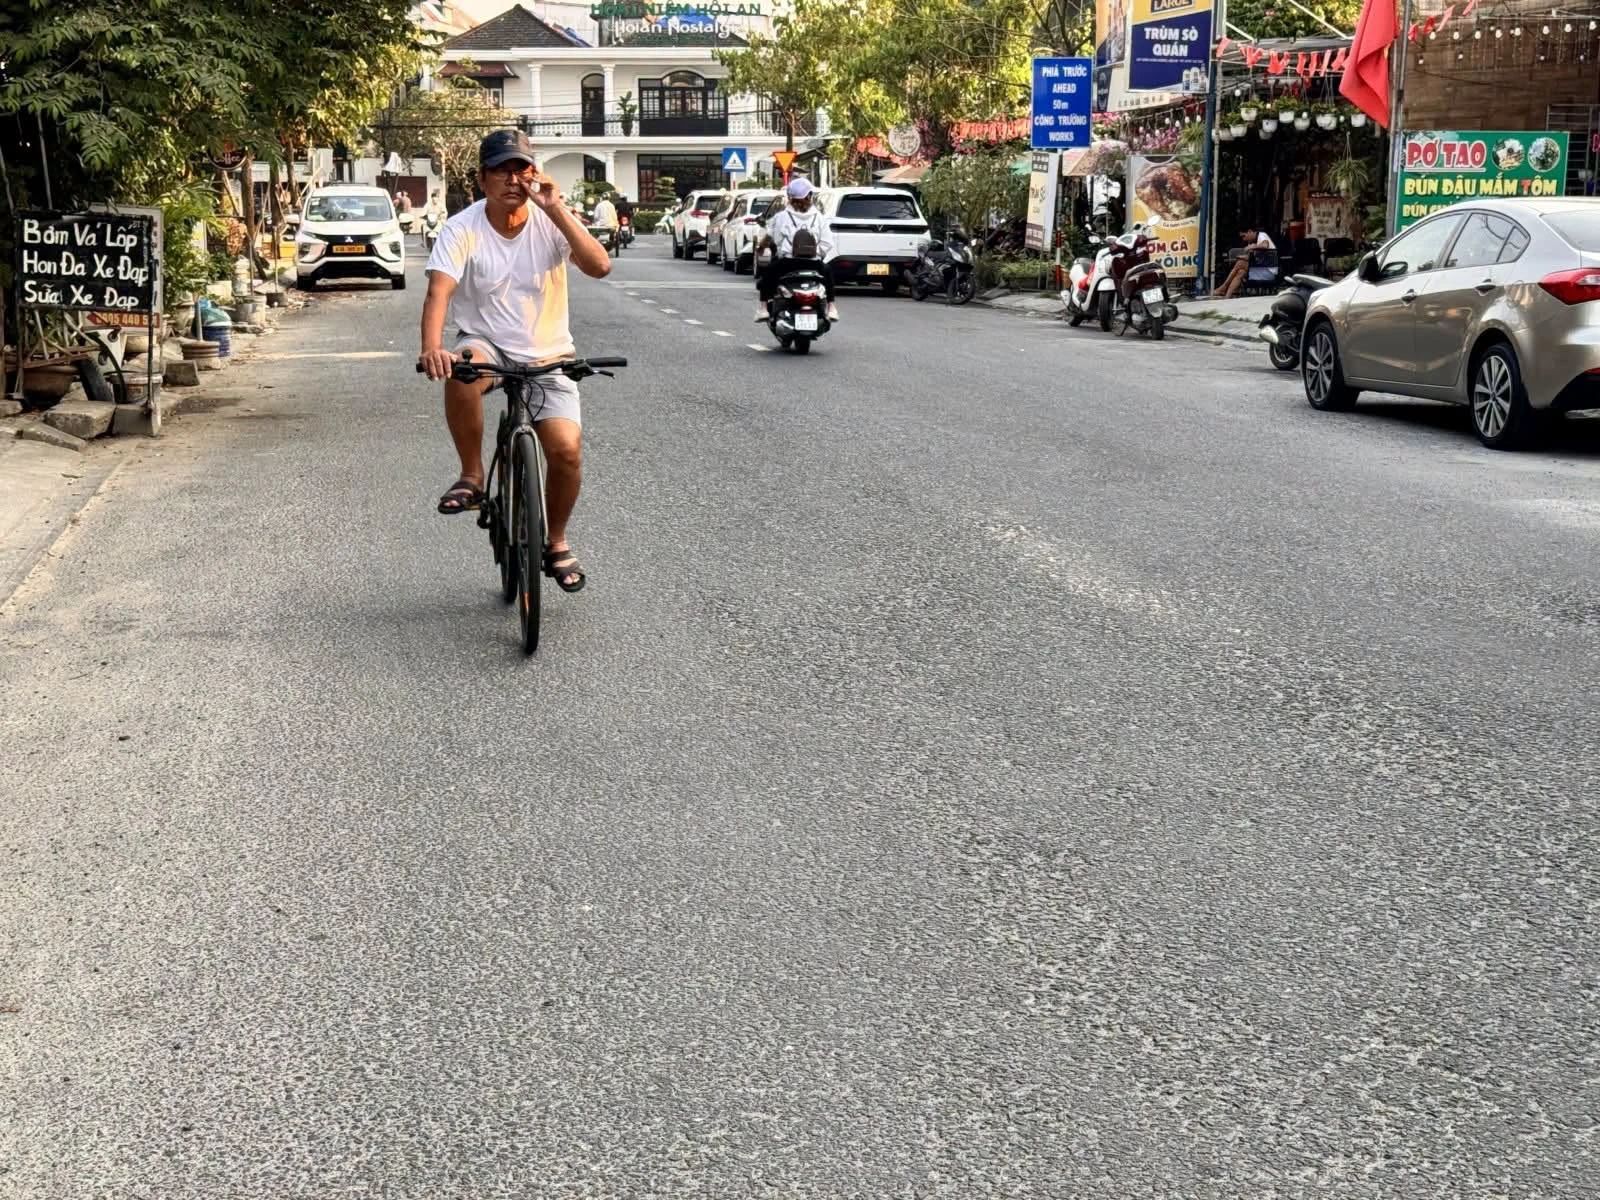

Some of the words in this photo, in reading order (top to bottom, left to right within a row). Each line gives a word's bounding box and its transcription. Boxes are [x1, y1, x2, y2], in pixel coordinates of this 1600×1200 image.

[737, 3, 761, 16] AN
[1144, 25, 1179, 40] TRÙM
[1182, 26, 1199, 41] SÒ
[1152, 41, 1188, 57] QUÁN
[1052, 83, 1077, 94] AHEAD
[1034, 114, 1055, 126] CÔNG
[1049, 131, 1074, 142] WORKS
[1442, 140, 1487, 168] TAO
[1404, 175, 1439, 196] BÚN
[1442, 174, 1476, 200] ĐẬU
[1480, 172, 1518, 196] MẮM
[1522, 175, 1557, 196] TÔM
[1402, 201, 1428, 217] BÚN
[1170, 236, 1189, 252] GÀ
[23, 250, 57, 275] Hon
[60, 251, 86, 276] Đa
[93, 253, 115, 278] Xe
[117, 255, 148, 287] Đạp
[70, 284, 93, 305] Xe
[104, 286, 139, 311] Đạp
